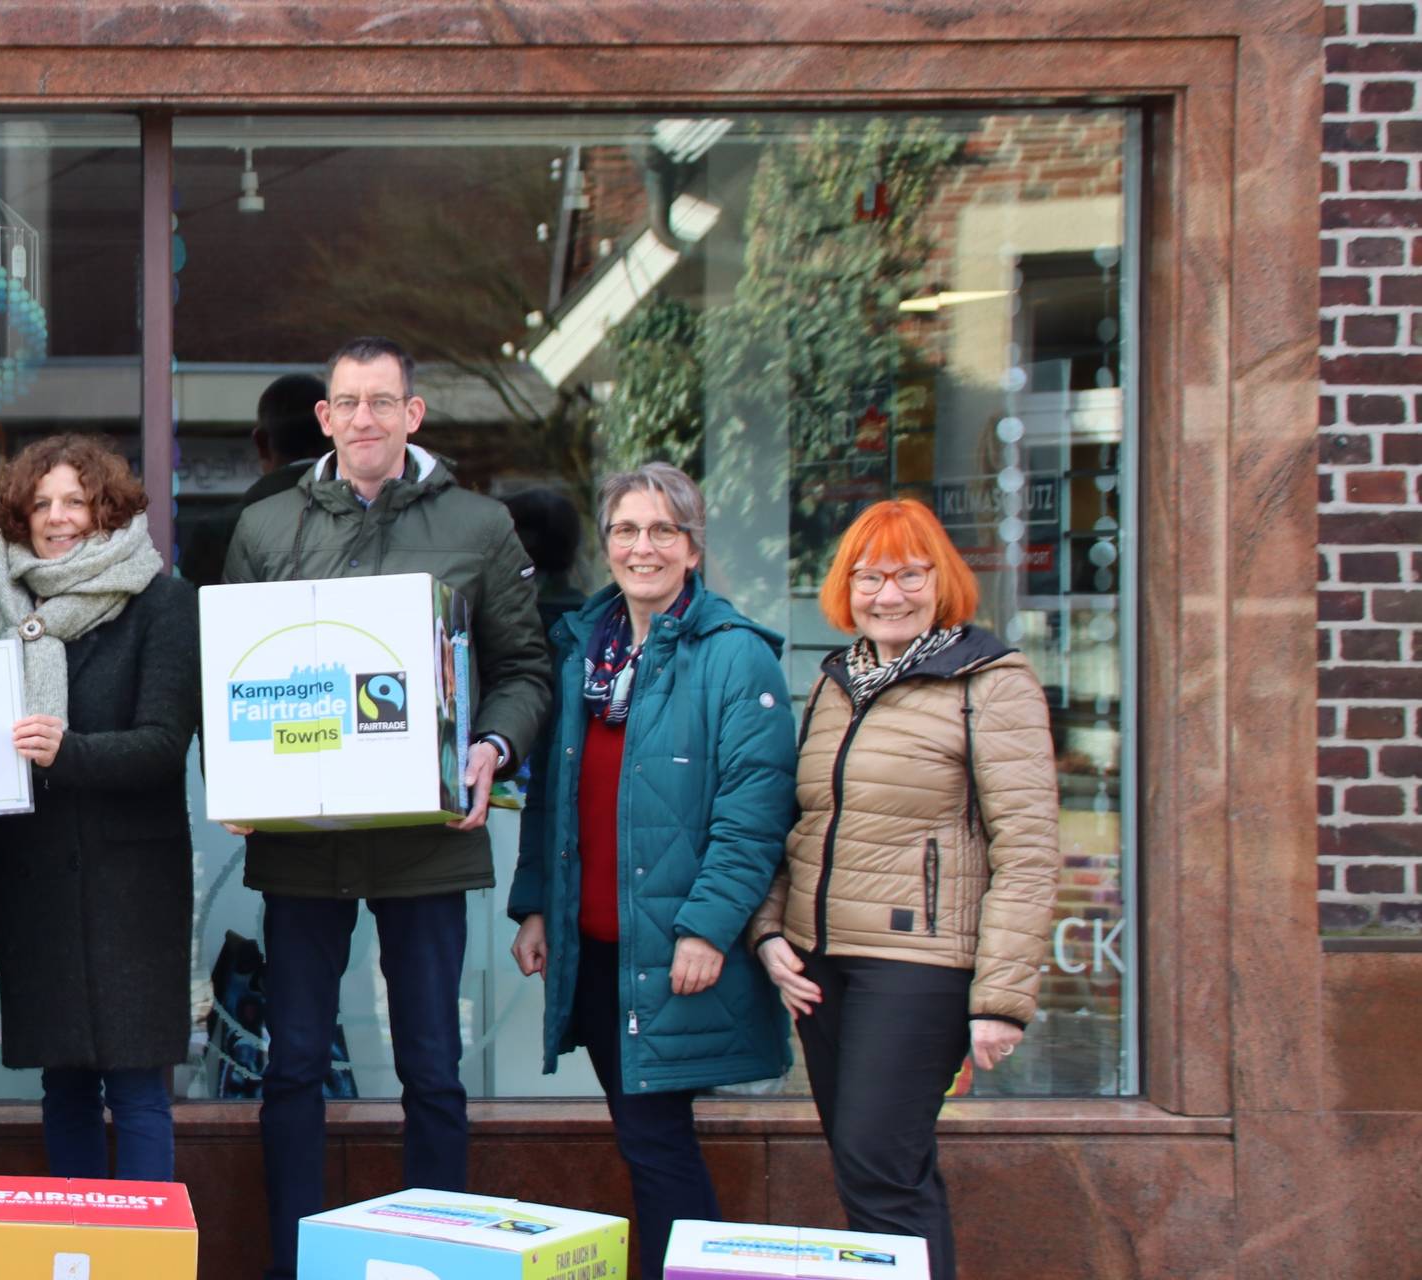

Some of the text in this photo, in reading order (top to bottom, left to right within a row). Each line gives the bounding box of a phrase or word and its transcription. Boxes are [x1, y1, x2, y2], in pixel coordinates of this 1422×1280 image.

[943, 484, 1054, 515] KLIMASUTZ
[231, 680, 334, 700] Kampagne
[231, 695, 347, 721] Fairtrade
[276, 727, 339, 745] Towns
[358, 720, 407, 731] FAIRTRADE
[1040, 917, 1127, 974] CK
